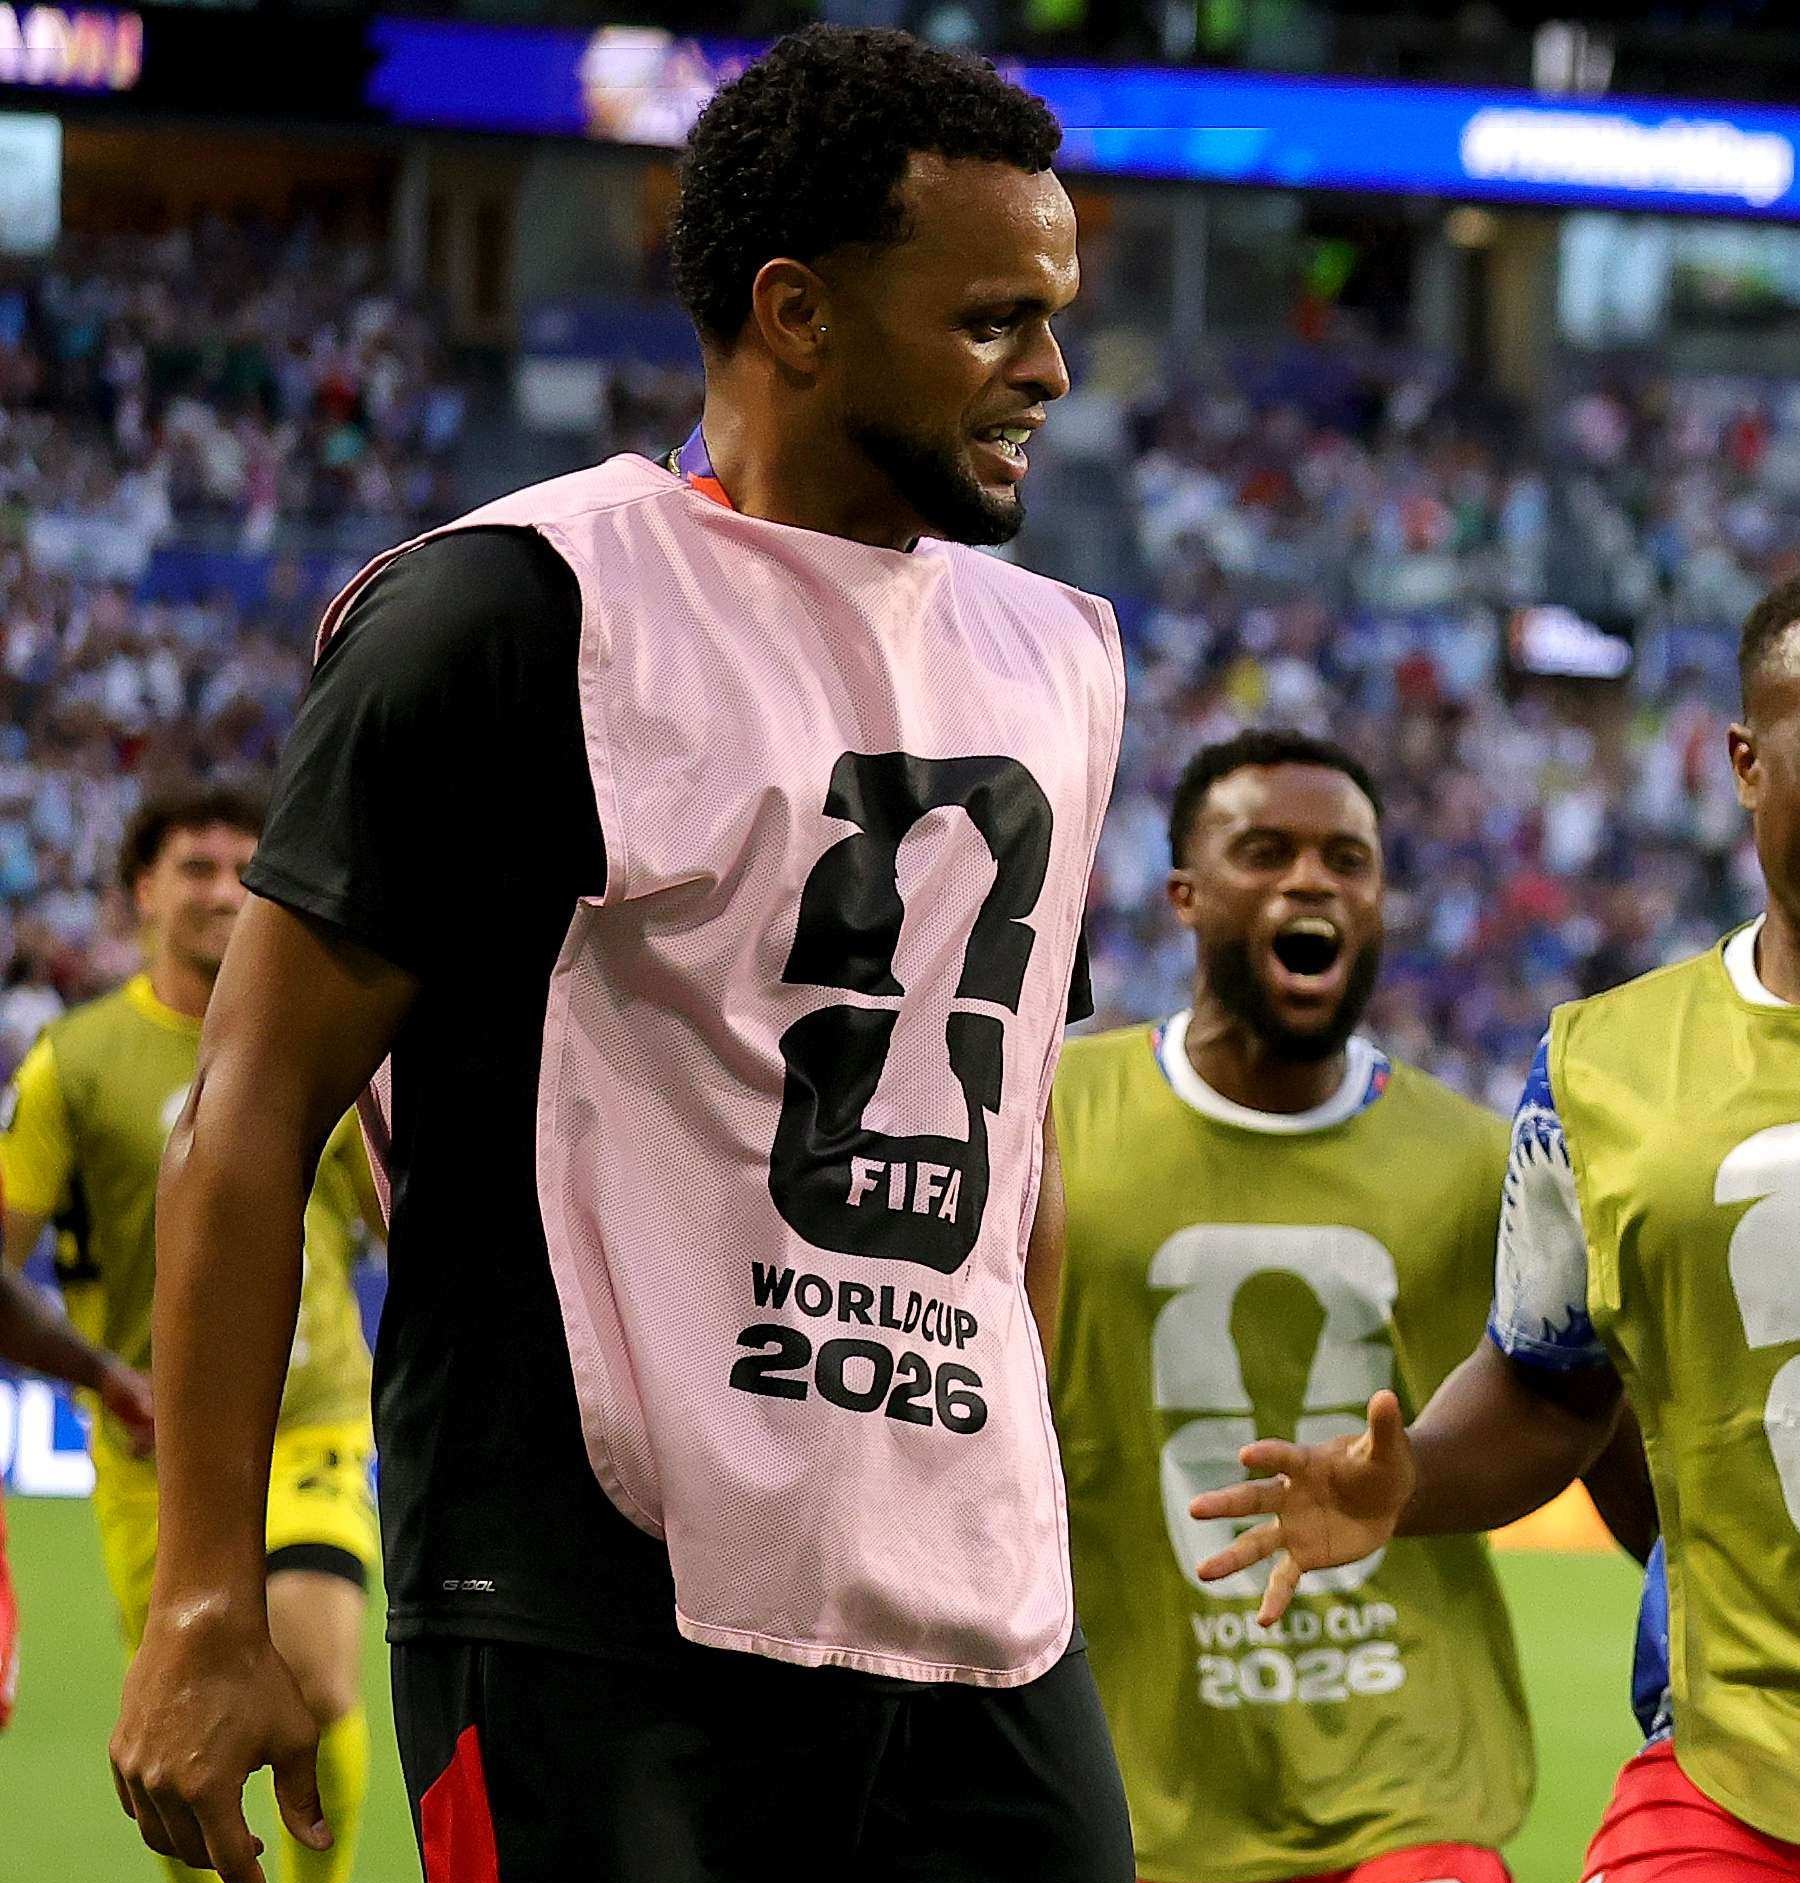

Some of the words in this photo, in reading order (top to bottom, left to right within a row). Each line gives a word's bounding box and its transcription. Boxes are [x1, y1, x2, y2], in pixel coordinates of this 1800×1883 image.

[846, 1155, 962, 1224] FIFA
[729, 1323, 988, 1435] 2026
[1197, 1640, 1408, 1709] 2026
